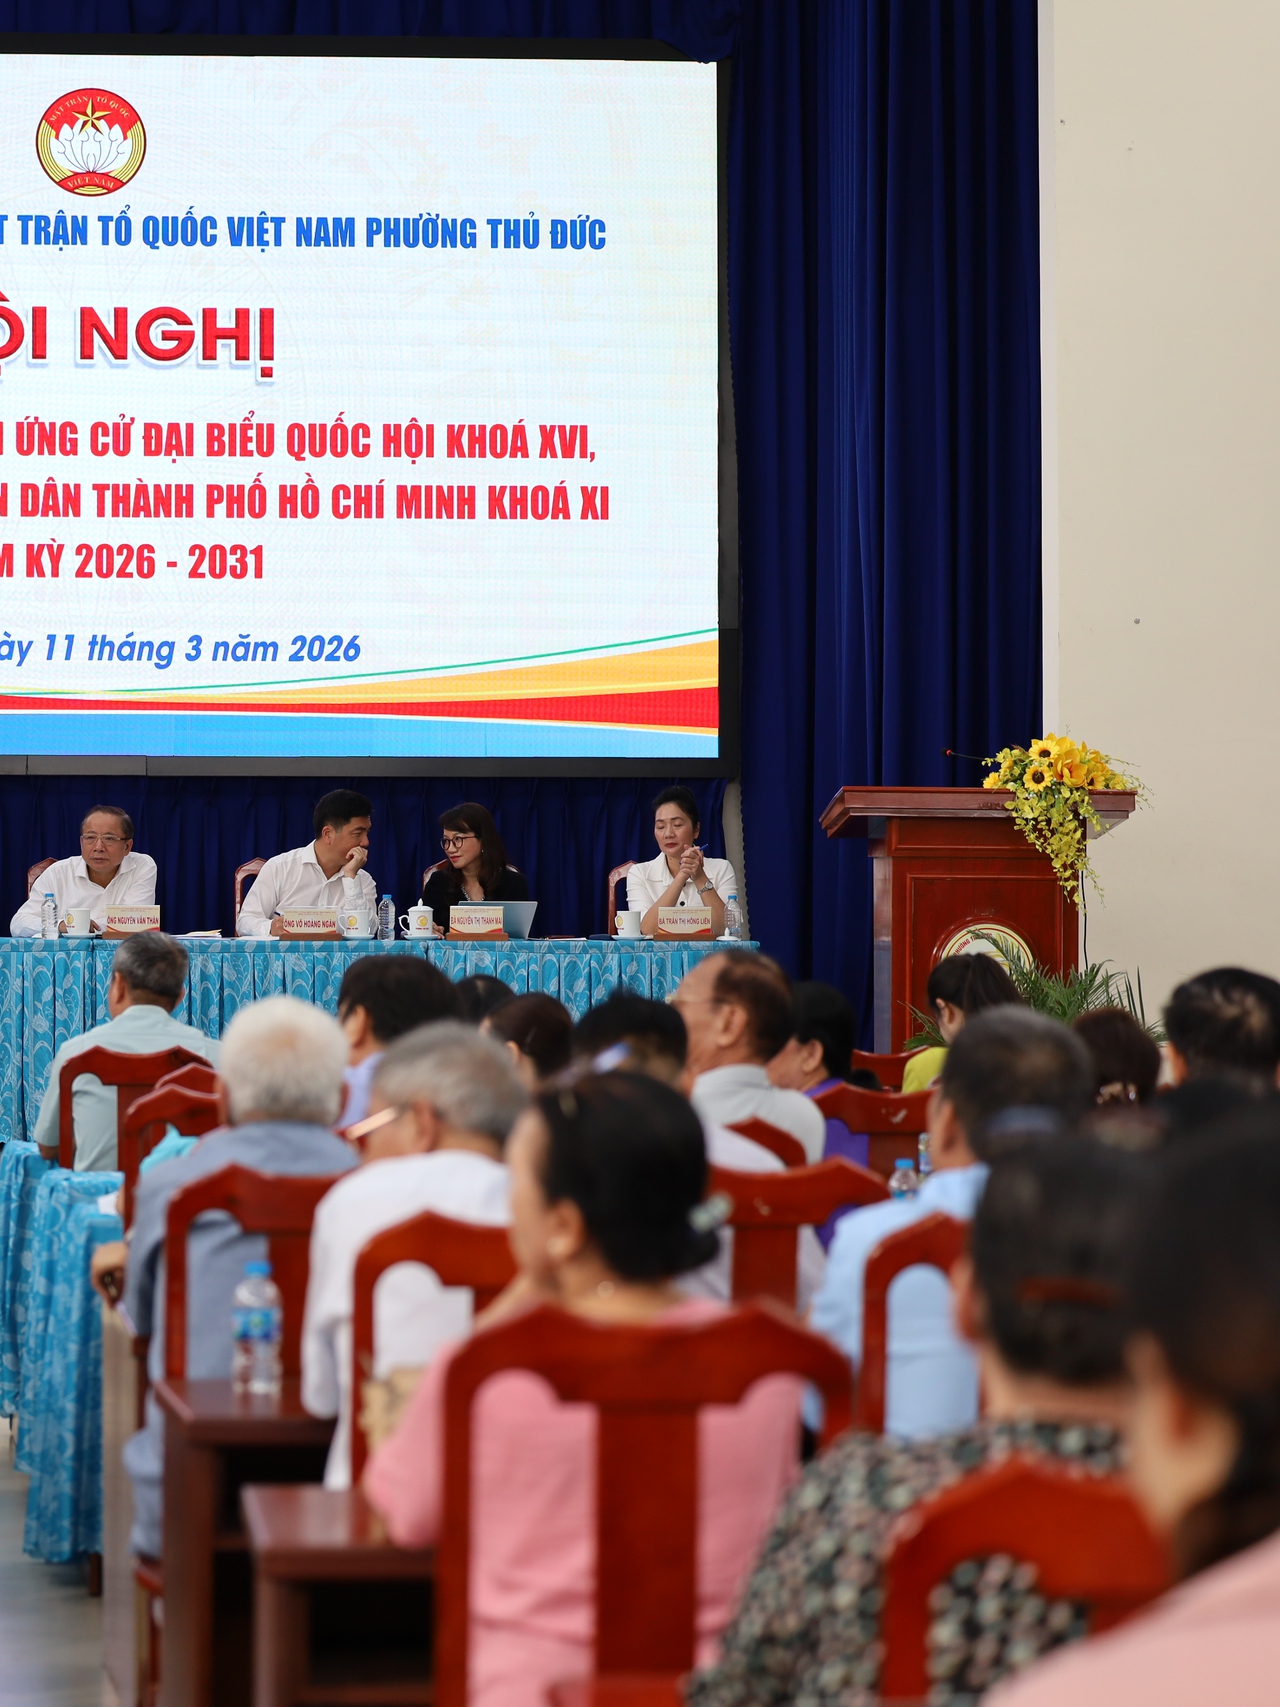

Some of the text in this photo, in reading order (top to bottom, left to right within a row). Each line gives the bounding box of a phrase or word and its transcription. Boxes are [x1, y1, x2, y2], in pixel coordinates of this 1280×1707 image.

[94, 176, 114, 188] NAM
[17, 210, 88, 251] TRẬN
[98, 204, 132, 246] TỔ
[142, 206, 217, 250] QUỐC
[227, 211, 286, 253] VIỆT
[296, 217, 355, 247] NAM
[366, 212, 476, 249] PHƯỜNG
[486, 211, 539, 249] THỦ
[550, 214, 606, 250] ĐỨC
[80, 306, 275, 378] NGHỊ
[16, 416, 78, 456] ỨNG
[91, 414, 135, 456] CỬ
[143, 423, 193, 463] ĐẠI
[207, 411, 274, 457] BIỂU
[287, 412, 370, 461] QUỐC
[383, 418, 434, 464] HỘI
[447, 419, 529, 458] KHOÁ
[540, 425, 595, 462] XVI,
[21, 477, 80, 517] DÂN
[92, 478, 193, 518] THÀNH
[207, 473, 266, 519] PHỐ
[279, 473, 319, 519] HỒ
[332, 480, 384, 519] CHÍ
[397, 485, 475, 519] MINH
[489, 480, 570, 520] KHOÁ
[581, 486, 608, 520] XI
[26, 538, 64, 577] KỲ
[76, 544, 155, 578] 2026
[189, 544, 262, 579] 2031
[47, 634, 74, 661] 11
[88, 632, 175, 669] tháng
[185, 635, 202, 661] 3
[212, 634, 278, 662] năm
[289, 635, 360, 662] 2026
